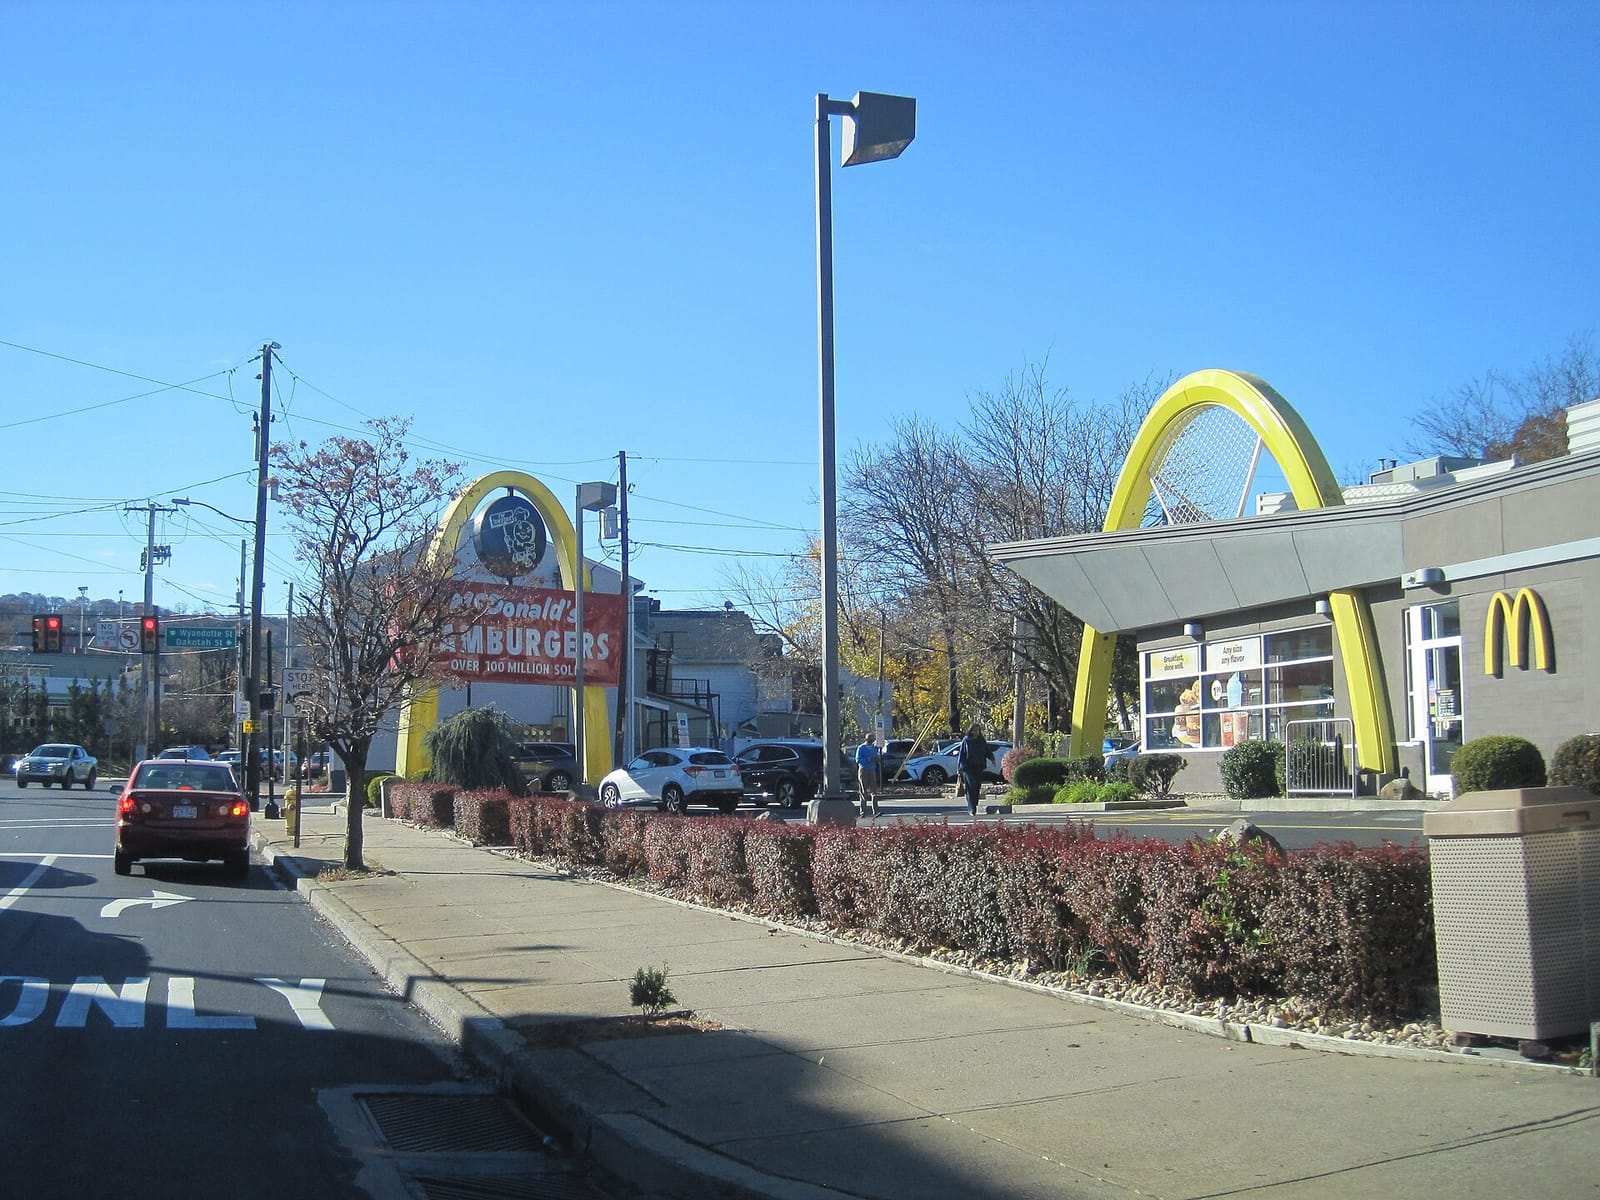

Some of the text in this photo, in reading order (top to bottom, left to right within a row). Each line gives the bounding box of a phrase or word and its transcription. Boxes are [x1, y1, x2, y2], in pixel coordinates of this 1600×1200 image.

[101, 623, 113, 631] NO
[180, 629, 233, 638] Wyandotte St
[176, 638, 223, 647] Dakotah St
[434, 623, 609, 661] AMBURGERS
[451, 659, 577, 676] OVER 100 MILLION SOL
[288, 672, 316, 683] STOP
